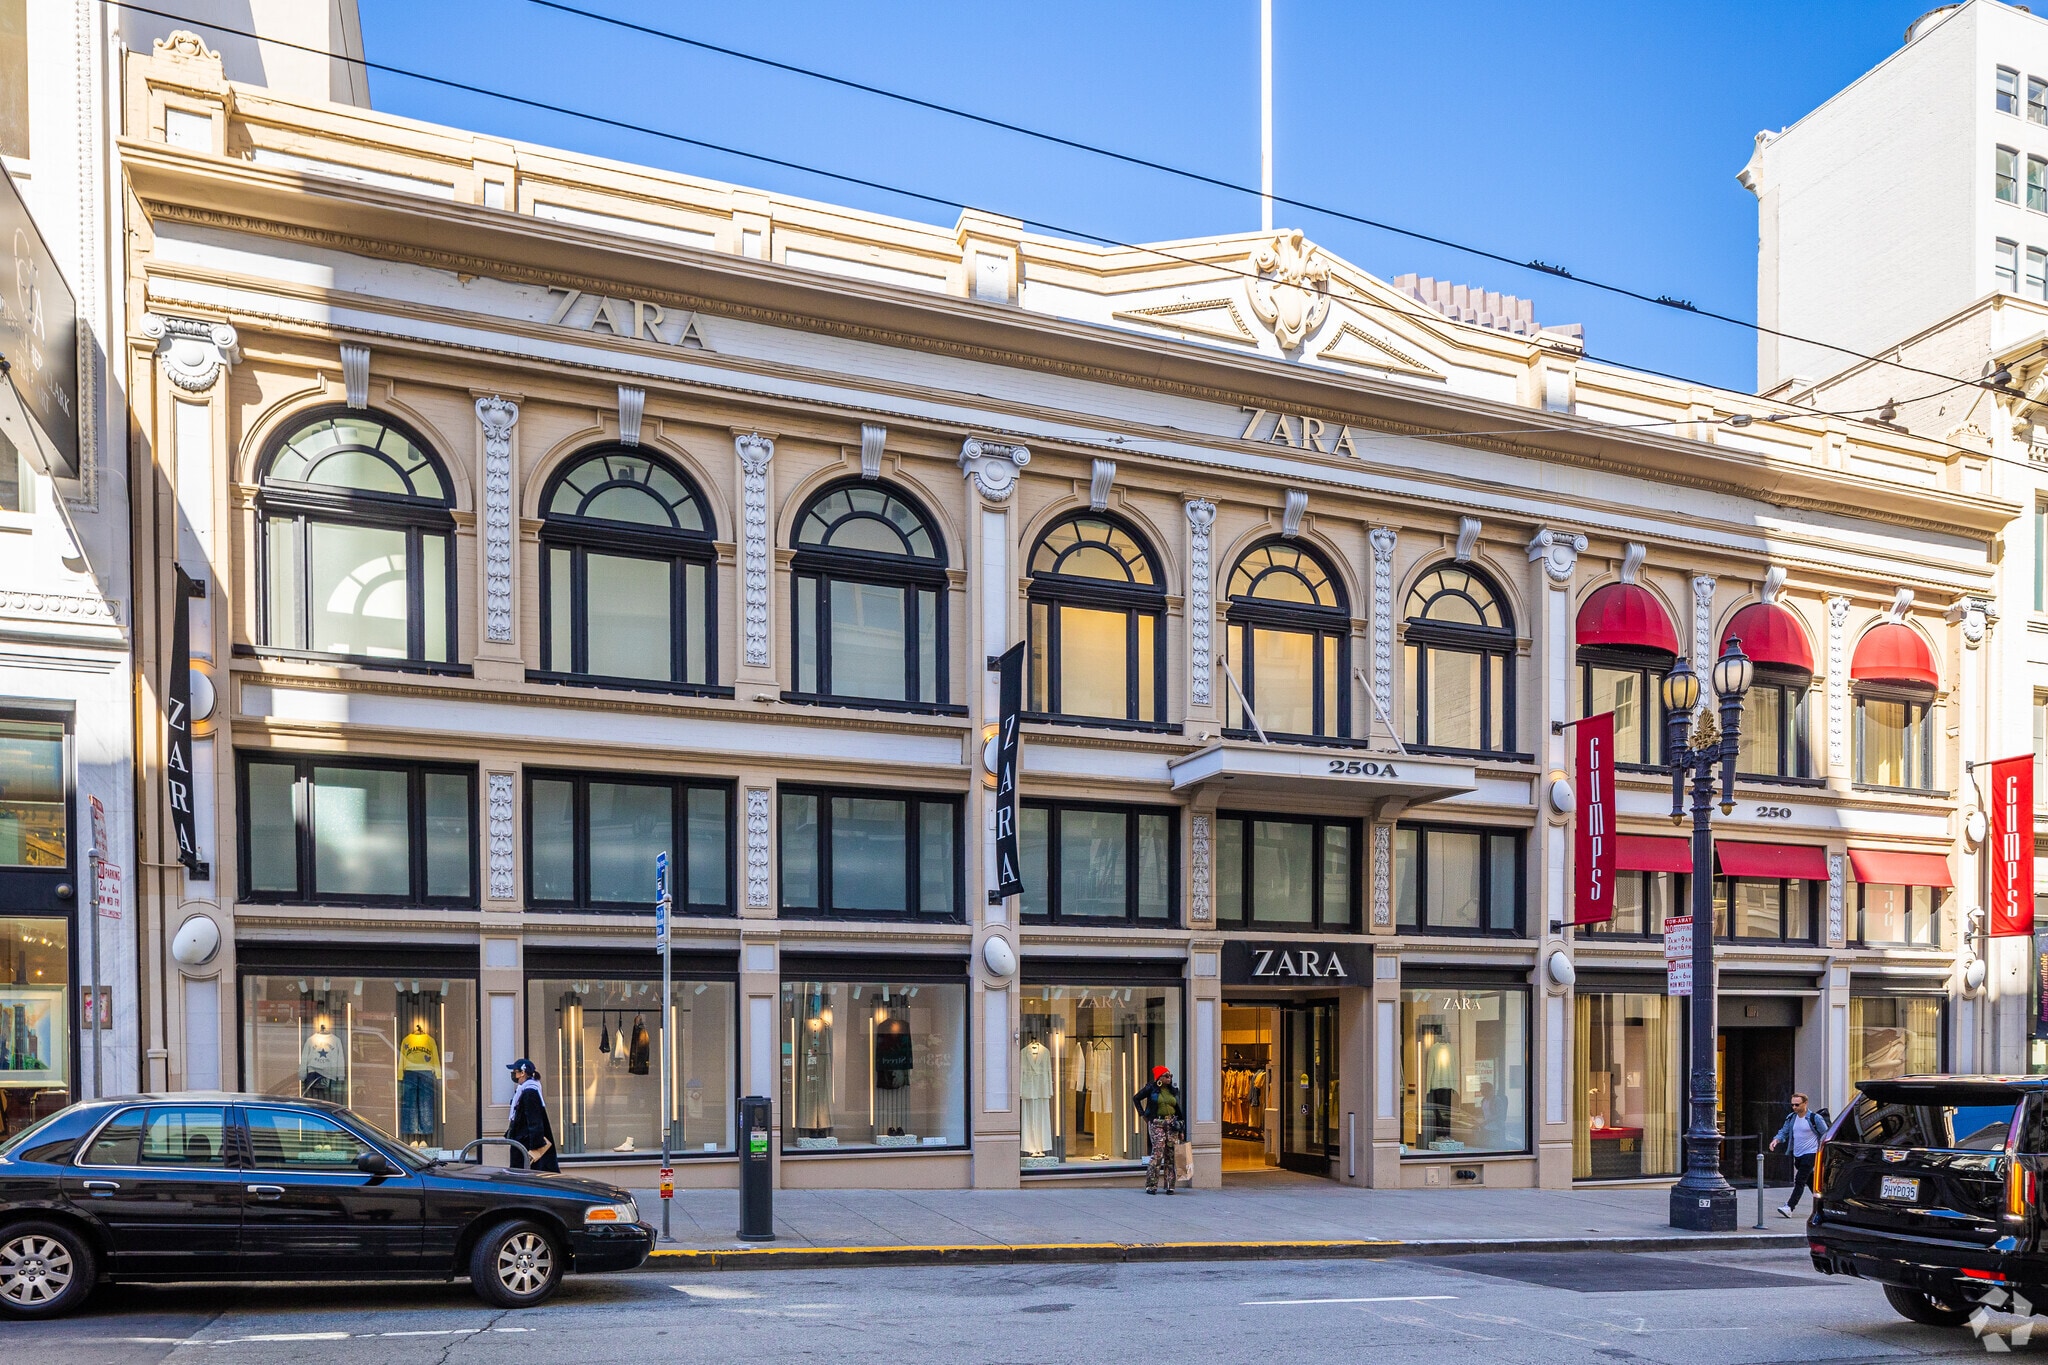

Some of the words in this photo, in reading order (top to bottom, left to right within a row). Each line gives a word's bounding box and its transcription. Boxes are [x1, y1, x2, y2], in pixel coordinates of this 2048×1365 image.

[547, 285, 717, 353] ZARA
[1240, 405, 1361, 459] ZARA
[168, 698, 194, 855] ZARA
[1328, 760, 1399, 778] 250A
[997, 714, 1018, 886] ZARA
[1589, 737, 1605, 901] GUMPS
[1756, 806, 1792, 819] 250
[2004, 776, 2020, 918] GUMPS
[1666, 925, 1673, 933] NO
[1251, 950, 1348, 978] ZARA
[1668, 961, 1676, 971] NO
[1077, 995, 1126, 1009] ZARA
[1442, 997, 1482, 1010] ZARA
[1884, 1185, 1915, 1198] 9HYP035
